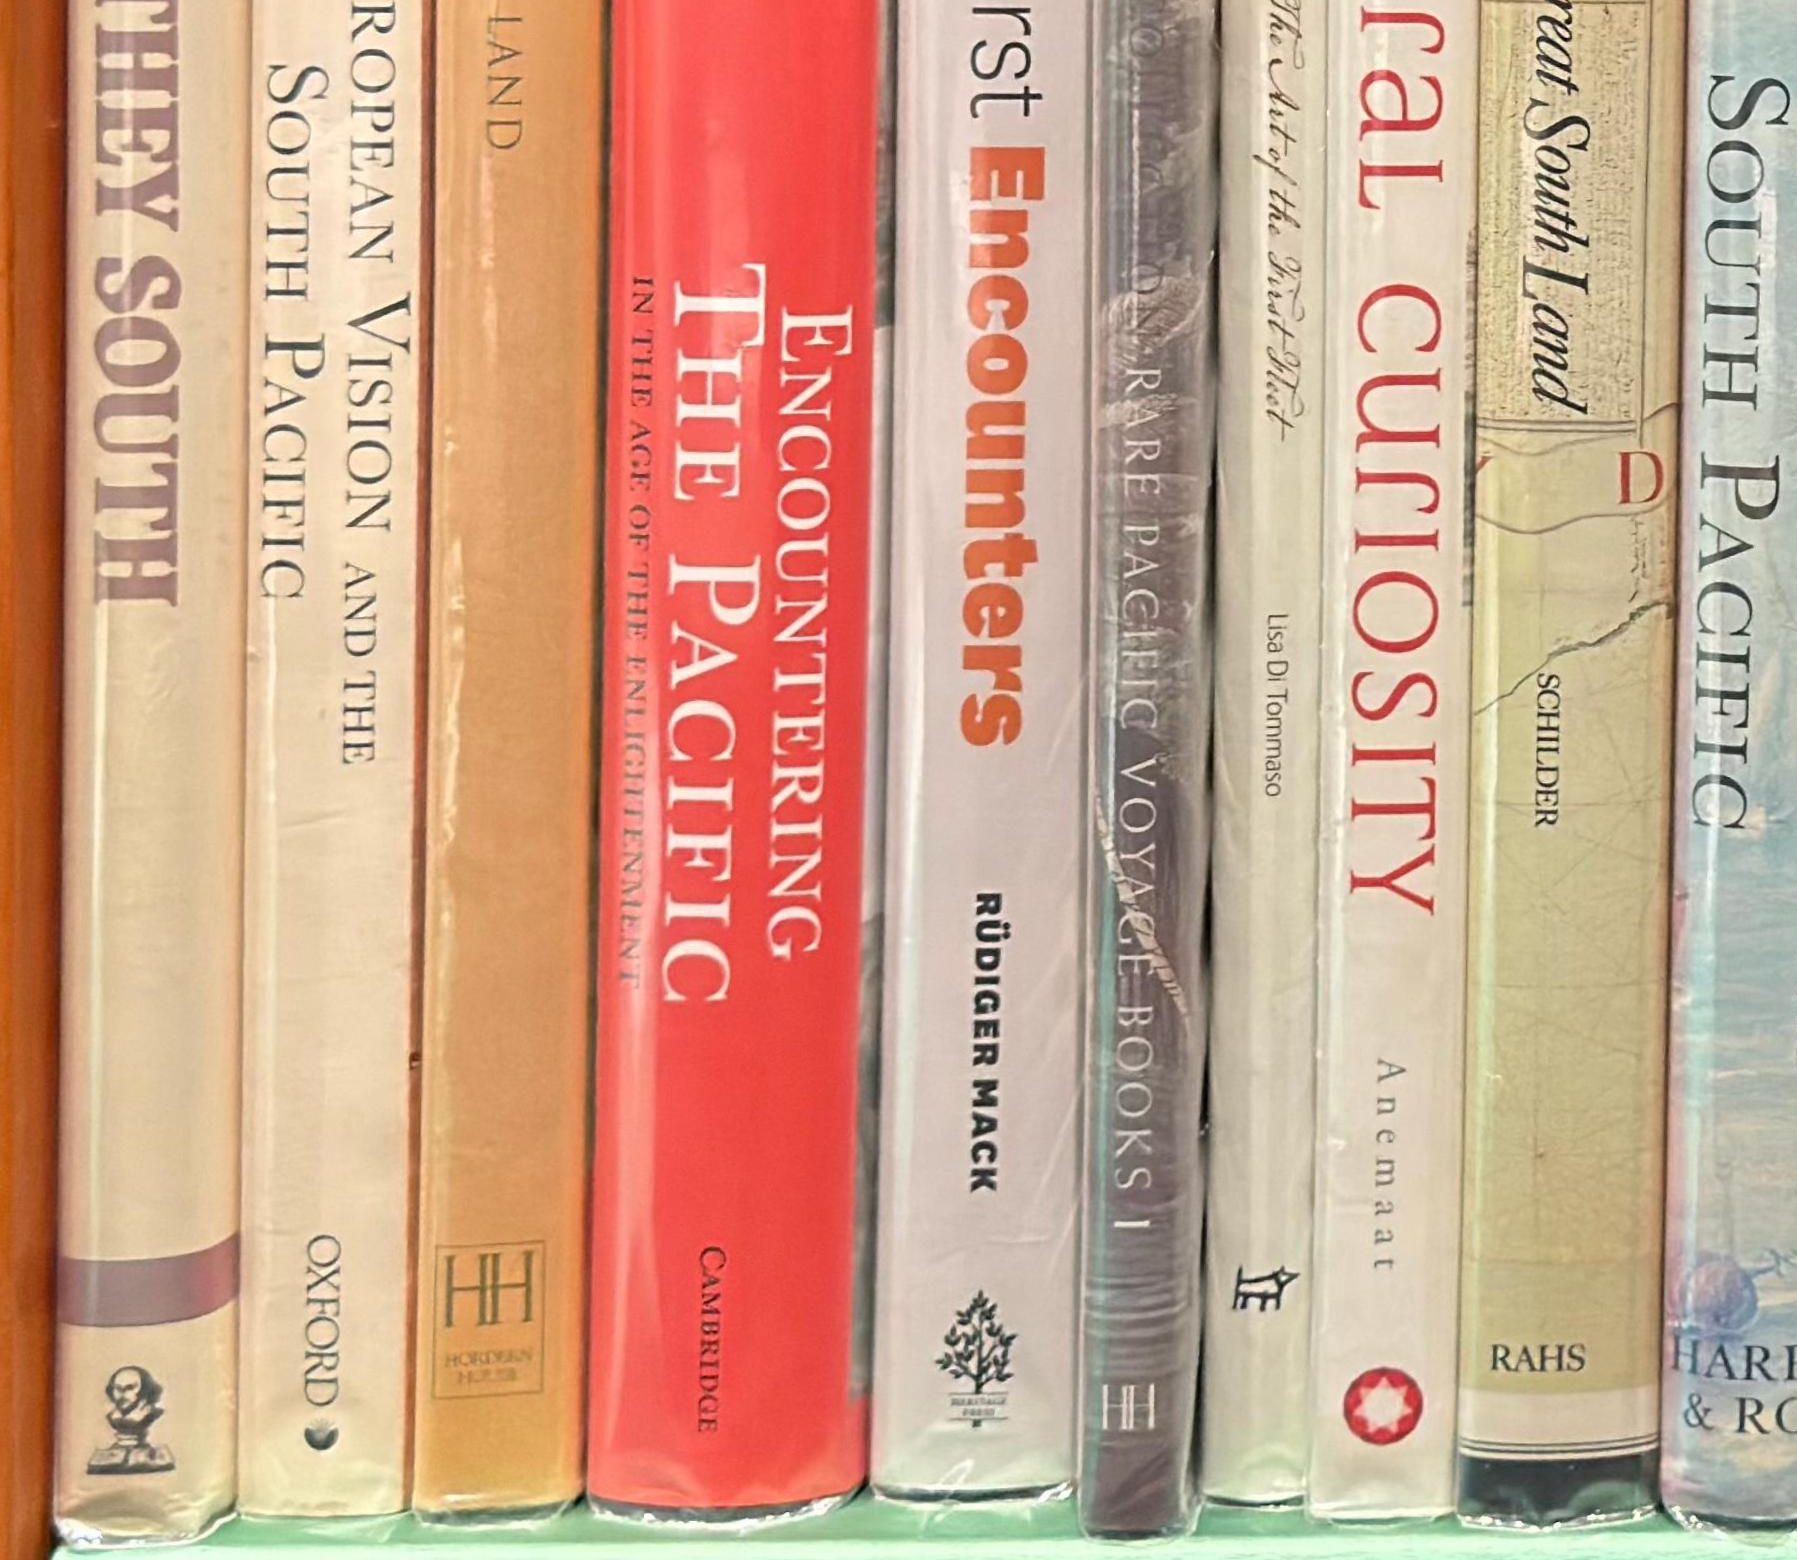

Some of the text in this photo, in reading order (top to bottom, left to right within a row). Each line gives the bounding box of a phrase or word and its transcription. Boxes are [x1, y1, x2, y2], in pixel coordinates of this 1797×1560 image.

[485, 16, 524, 151] LAND
[1522, 98, 1592, 254] South
[260, 63, 330, 599] SOUTH PACIFIC
[345, 292, 412, 533] VISION
[1521, 256, 1590, 415] Land
[93, 256, 181, 609] SOUTH
[625, 330, 654, 640] THE AGE THE
[959, 147, 1046, 747] Encounters
[1121, 368, 1162, 500] RARE
[1692, 74, 1791, 830] SOUTH PACIFIC
[342, 561, 377, 657] AND
[661, 262, 766, 1002] THE PACIFIC
[766, 304, 854, 961] ENCOUNTERING
[1119, 524, 1161, 731] PACIFIC
[341, 670, 376, 766] THE
[1264, 613, 1289, 798] Lisa Tommaso
[1533, 673, 1561, 828] SCHILDER
[1117, 758, 1158, 976] VOYAGE
[969, 891, 1011, 1193] RÜDIGER MACK
[1114, 1006, 1153, 1190] BOOKS
[1373, 1057, 1408, 1270] Anemaat
[305, 1233, 342, 1408] OXFORD
[697, 1245, 727, 1433] CAMBRIDGE
[1490, 1342, 1586, 1373] RAHS
[1683, 1392, 1711, 1431] &
